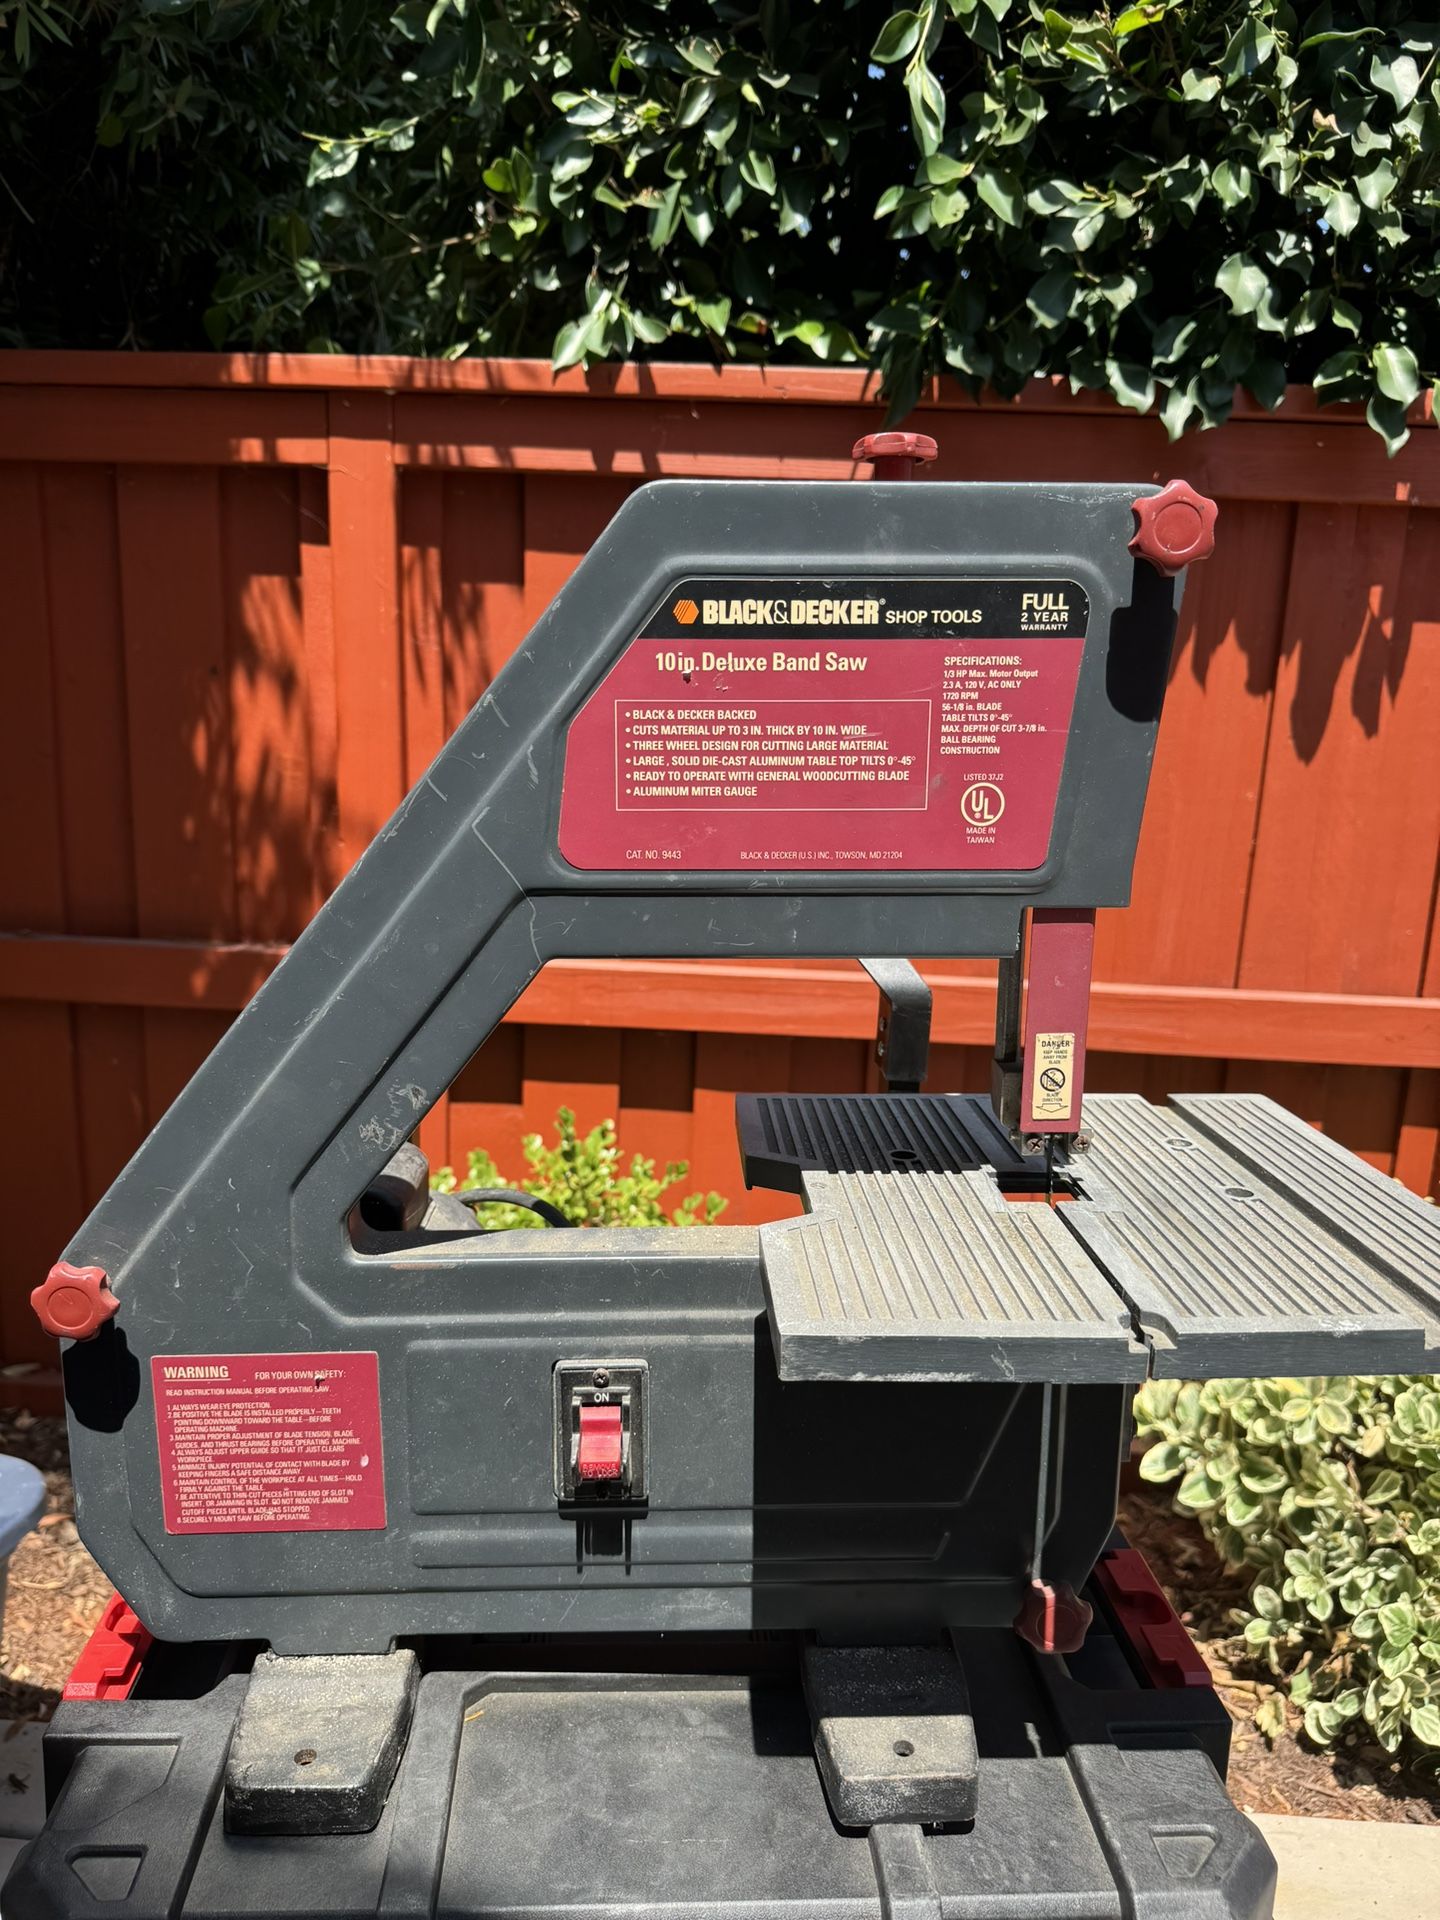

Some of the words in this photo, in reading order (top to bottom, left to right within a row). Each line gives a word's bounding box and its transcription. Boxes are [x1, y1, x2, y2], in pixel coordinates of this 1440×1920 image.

[1022, 593, 1070, 610] FULL
[886, 610, 927, 624] SHOP
[931, 609, 982, 624] TOOLS
[1020, 612, 1028, 622] 2
[1033, 612, 1068, 622] YEAR
[702, 652, 767, 672] Deluxe
[772, 652, 820, 672] Band
[825, 652, 868, 672] Saw
[944, 656, 1022, 666] SPECIFICATIONS:
[944, 670, 955, 678] 1/3
[956, 670, 968, 678] HP
[968, 670, 988, 678] Max.
[989, 670, 1012, 678] Motor
[1013, 670, 1038, 678] Output
[942, 681, 954, 689] 2.3
[955, 681, 964, 689] A,
[965, 681, 978, 689] 120
[978, 681, 986, 689] V,
[988, 681, 999, 689] AC
[1000, 681, 1022, 689] ONLY
[942, 692, 960, 700] 1720
[960, 692, 978, 700] RPM
[942, 703, 964, 711] 56-1/8
[966, 703, 976, 711] in.
[976, 703, 1002, 711] BLADE
[632, 710, 665, 720] BLACK
[667, 710, 675, 720] &
[678, 710, 715, 720] DECKER
[718, 710, 757, 720] BACKED
[632, 725, 658, 735] CUTS
[660, 725, 710, 735] MATERIAL
[712, 725, 726, 735] UP
[728, 725, 740, 735] TO
[742, 725, 748, 735] 3
[750, 725, 764, 735] IN.
[766, 725, 795, 735] THICK
[797, 725, 810, 735] BY
[812, 725, 823, 735] 10
[825, 725, 838, 735] IN.
[841, 725, 867, 735] WIDE
[941, 724, 961, 732] MAX.
[963, 724, 988, 732] DEPTH
[990, 724, 1000, 732] OF
[1002, 724, 1017, 732] CUT
[1018, 724, 1036, 732] 3-7/8
[1038, 724, 1048, 732] in.
[940, 736, 960, 744] BALL
[962, 736, 996, 744] BEARING
[632, 741, 664, 750] THREE
[666, 741, 700, 750] WHEEL
[702, 741, 738, 750] DESIGN
[741, 741, 759, 750] FOR
[762, 741, 804, 750] CUTTING
[806, 741, 837, 750] LARGE
[840, 741, 889, 750] MATERIAL
[940, 746, 1000, 754] CONSTRUCTION
[672, 756, 700, 766] SOLID
[702, 756, 747, 766] DIE-CAST
[750, 756, 805, 766] ALUMINUM
[807, 756, 837, 766] TABLE
[839, 756, 858, 766] TOP
[860, 756, 886, 766] TILTS
[633, 771, 665, 781] READY
[668, 771, 681, 781] TO
[683, 771, 726, 781] OPERATE
[728, 771, 754, 781] WITH
[756, 771, 800, 781] GENERAL
[803, 771, 875, 781] WOODCUTTING
[878, 771, 909, 781] BLADE
[633, 786, 689, 796] ALUMINUM
[691, 786, 722, 796] MITER
[724, 786, 757, 796] GAUGE
[972, 790, 994, 820] UL
[626, 850, 643, 859] CAT.
[645, 850, 659, 859] NO.
[662, 850, 682, 859] 9443
[740, 851, 762, 860] BLACK
[764, 851, 769, 860] &
[771, 851, 799, 860] DECKER
[869, 851, 881, 860] MD
[883, 851, 902, 860] 21204
[164, 1366, 229, 1378] WARNING
[255, 1372, 270, 1380] FOR
[271, 1371, 292, 1379] YOUR
[294, 1370, 314, 1379] OWN
[594, 1392, 609, 1402] ON
